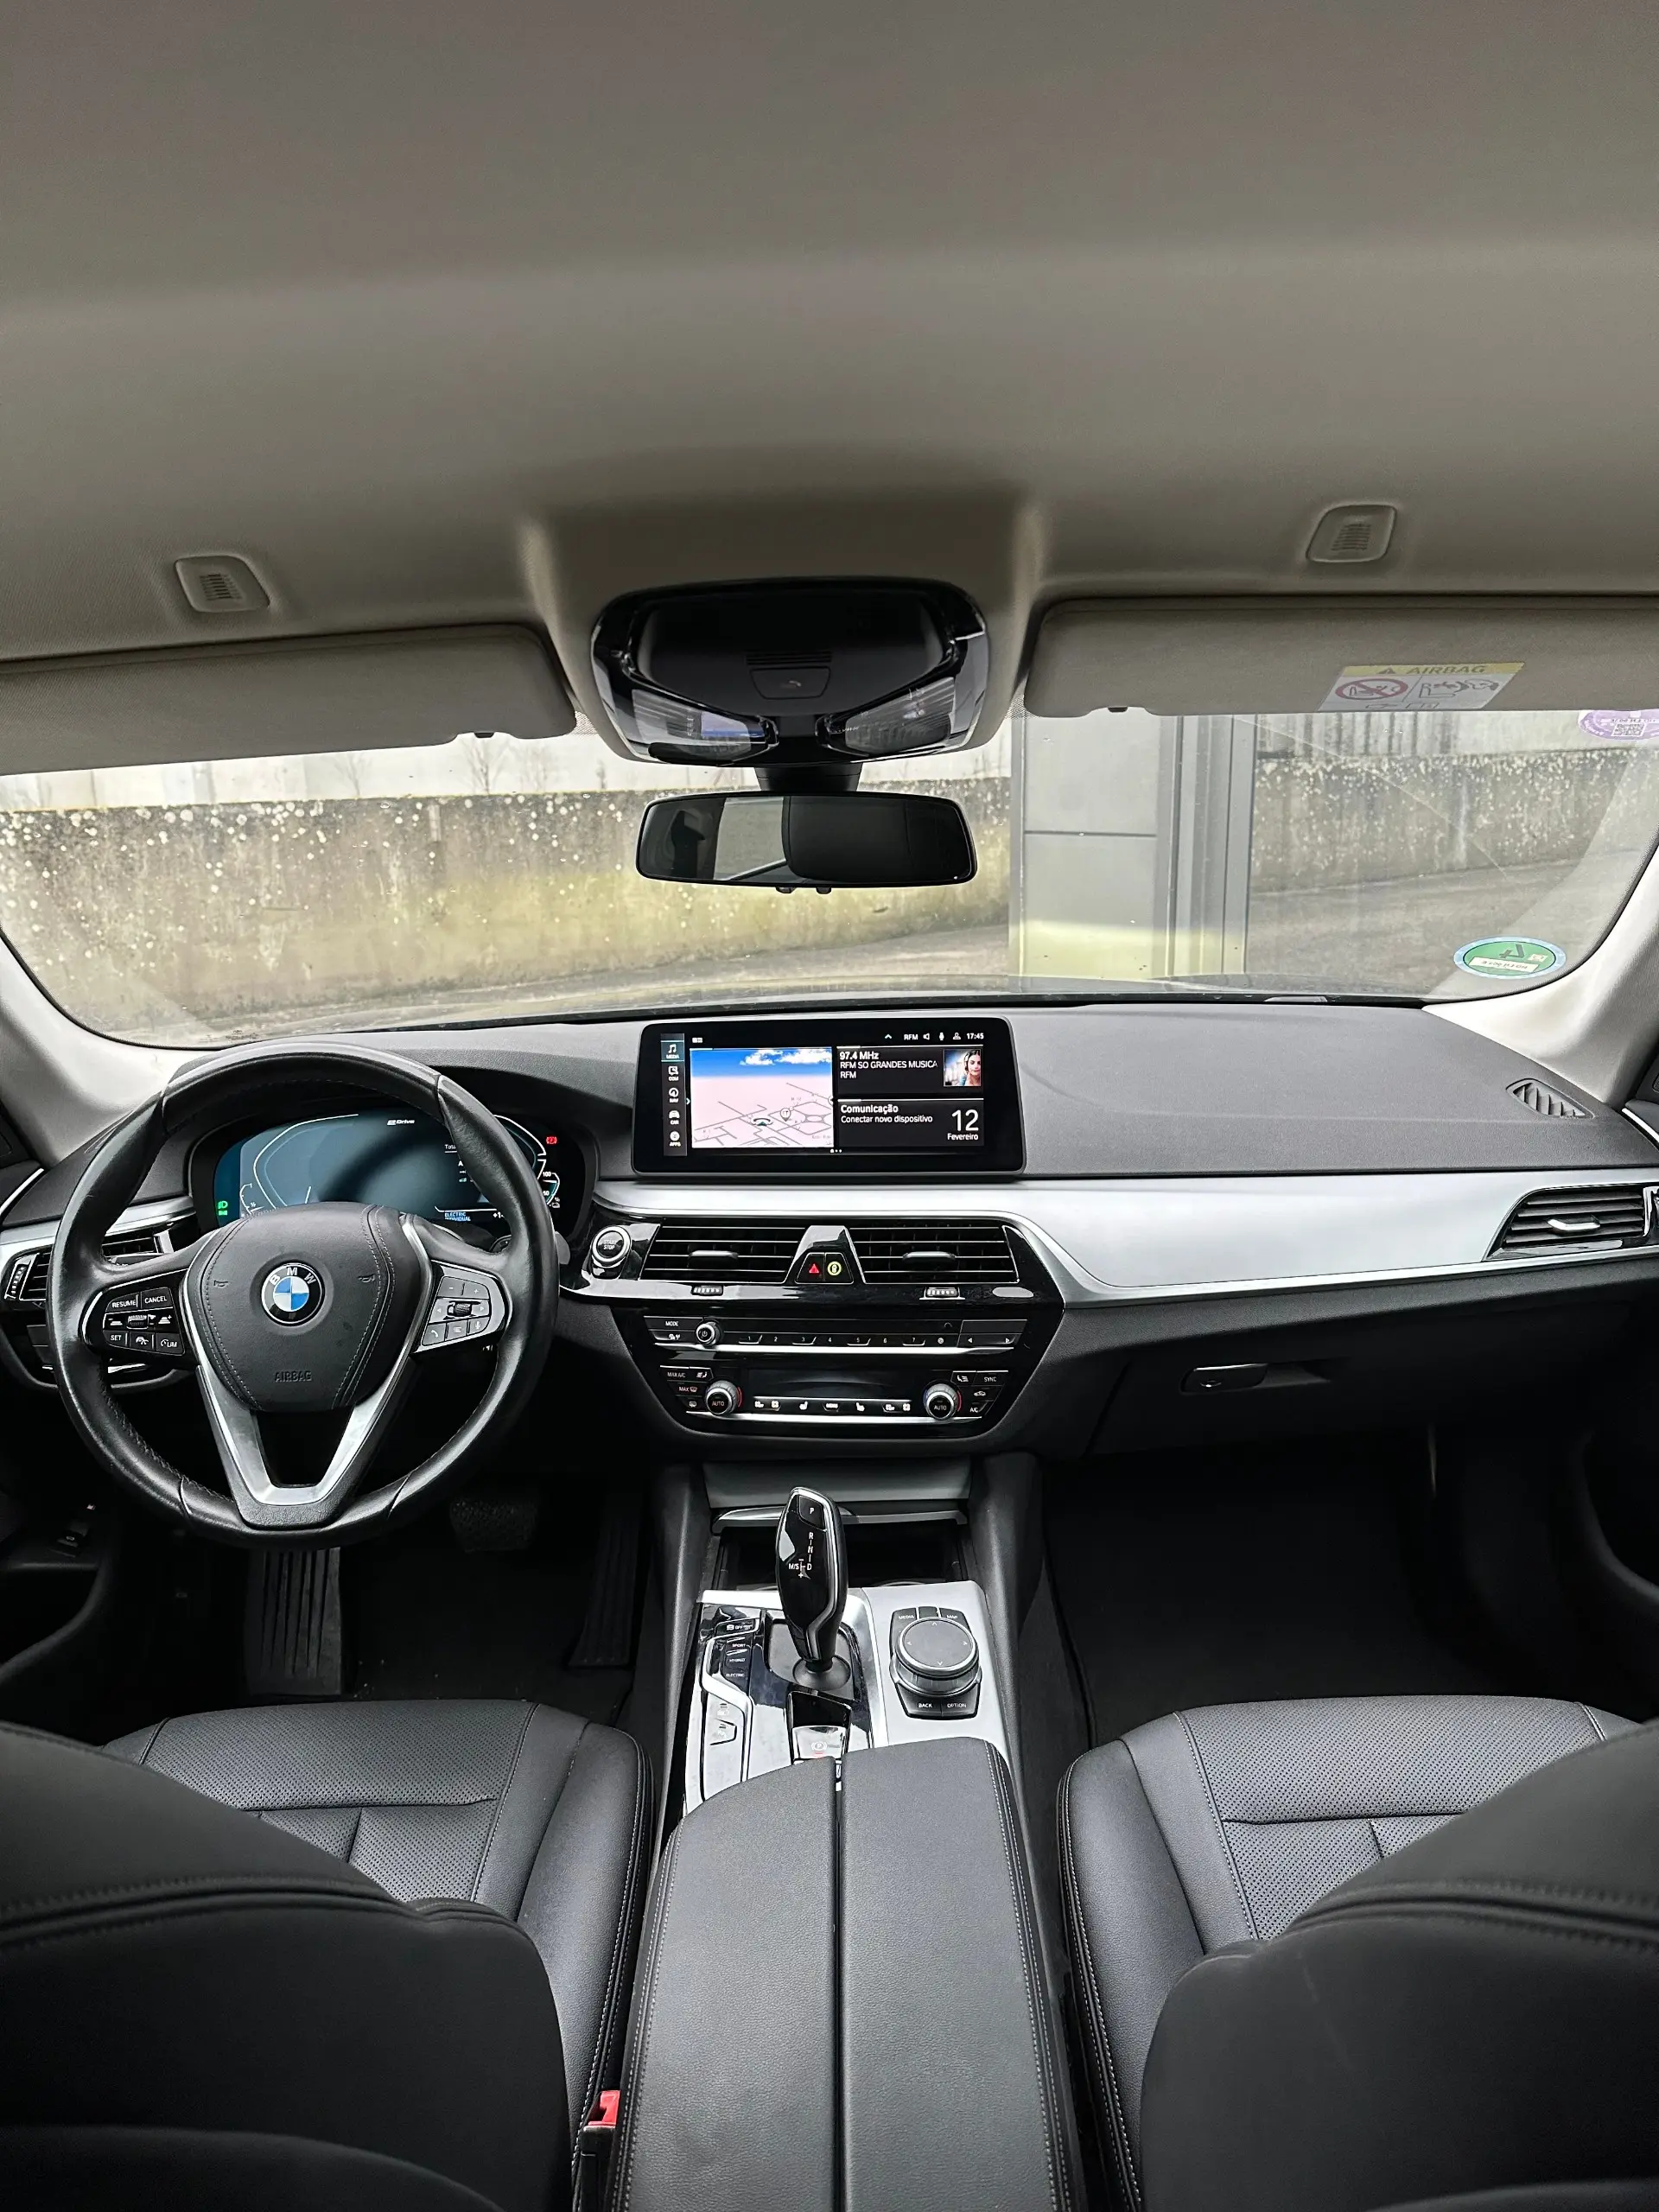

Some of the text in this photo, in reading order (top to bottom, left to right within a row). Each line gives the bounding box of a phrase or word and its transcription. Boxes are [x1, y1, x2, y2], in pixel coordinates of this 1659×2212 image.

[1406, 665, 1485, 674] AIRBAG
[839, 1052, 880, 1060] 97.4 MHz
[840, 1104, 899, 1115] Comunicação
[841, 1115, 873, 1123] Conectar
[893, 1115, 933, 1123] dispositivo
[951, 1109, 979, 1132] 12
[269, 1267, 316, 1286] BMW
[275, 1371, 312, 1382] AIRBAG
[808, 1531, 814, 1540] R
[807, 1545, 814, 1554] N
[806, 1562, 812, 1571] D
